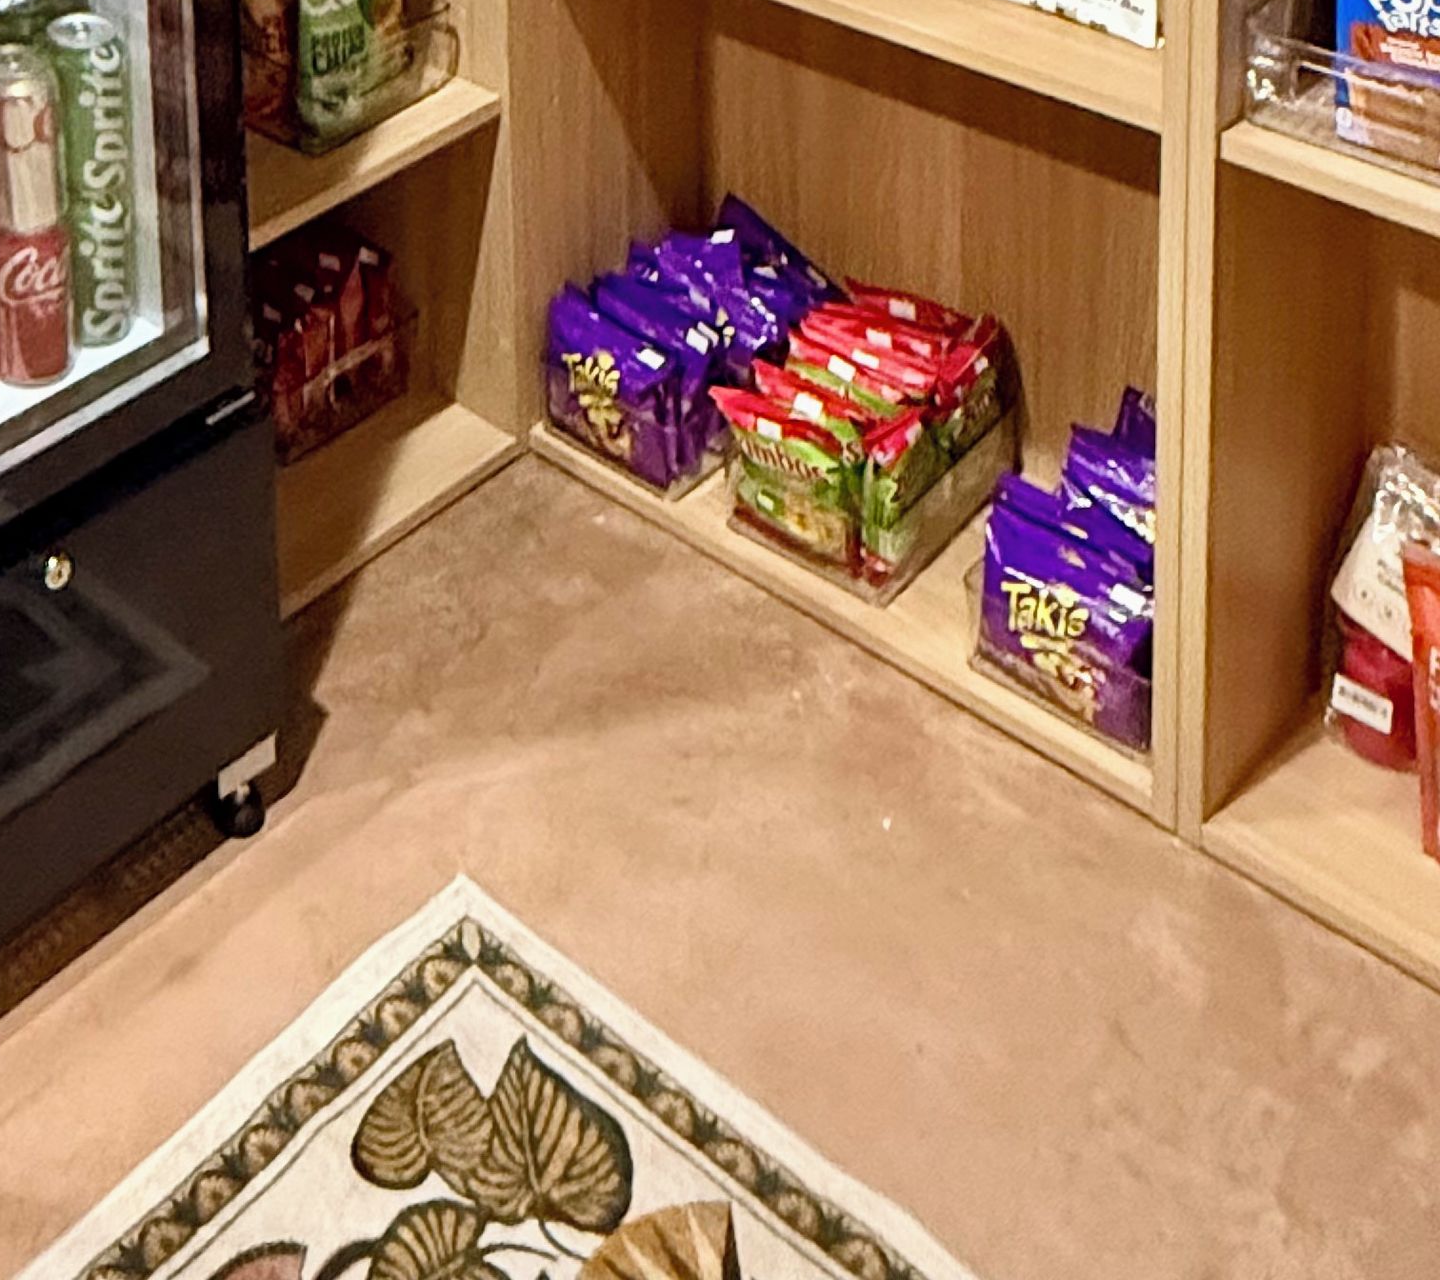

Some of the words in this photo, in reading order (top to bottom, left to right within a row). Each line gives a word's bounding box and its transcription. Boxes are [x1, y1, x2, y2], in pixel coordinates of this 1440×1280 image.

[78, 43, 128, 190] Sprite
[78, 195, 128, 340] Sprite
[1001, 581, 1089, 638] Takis
